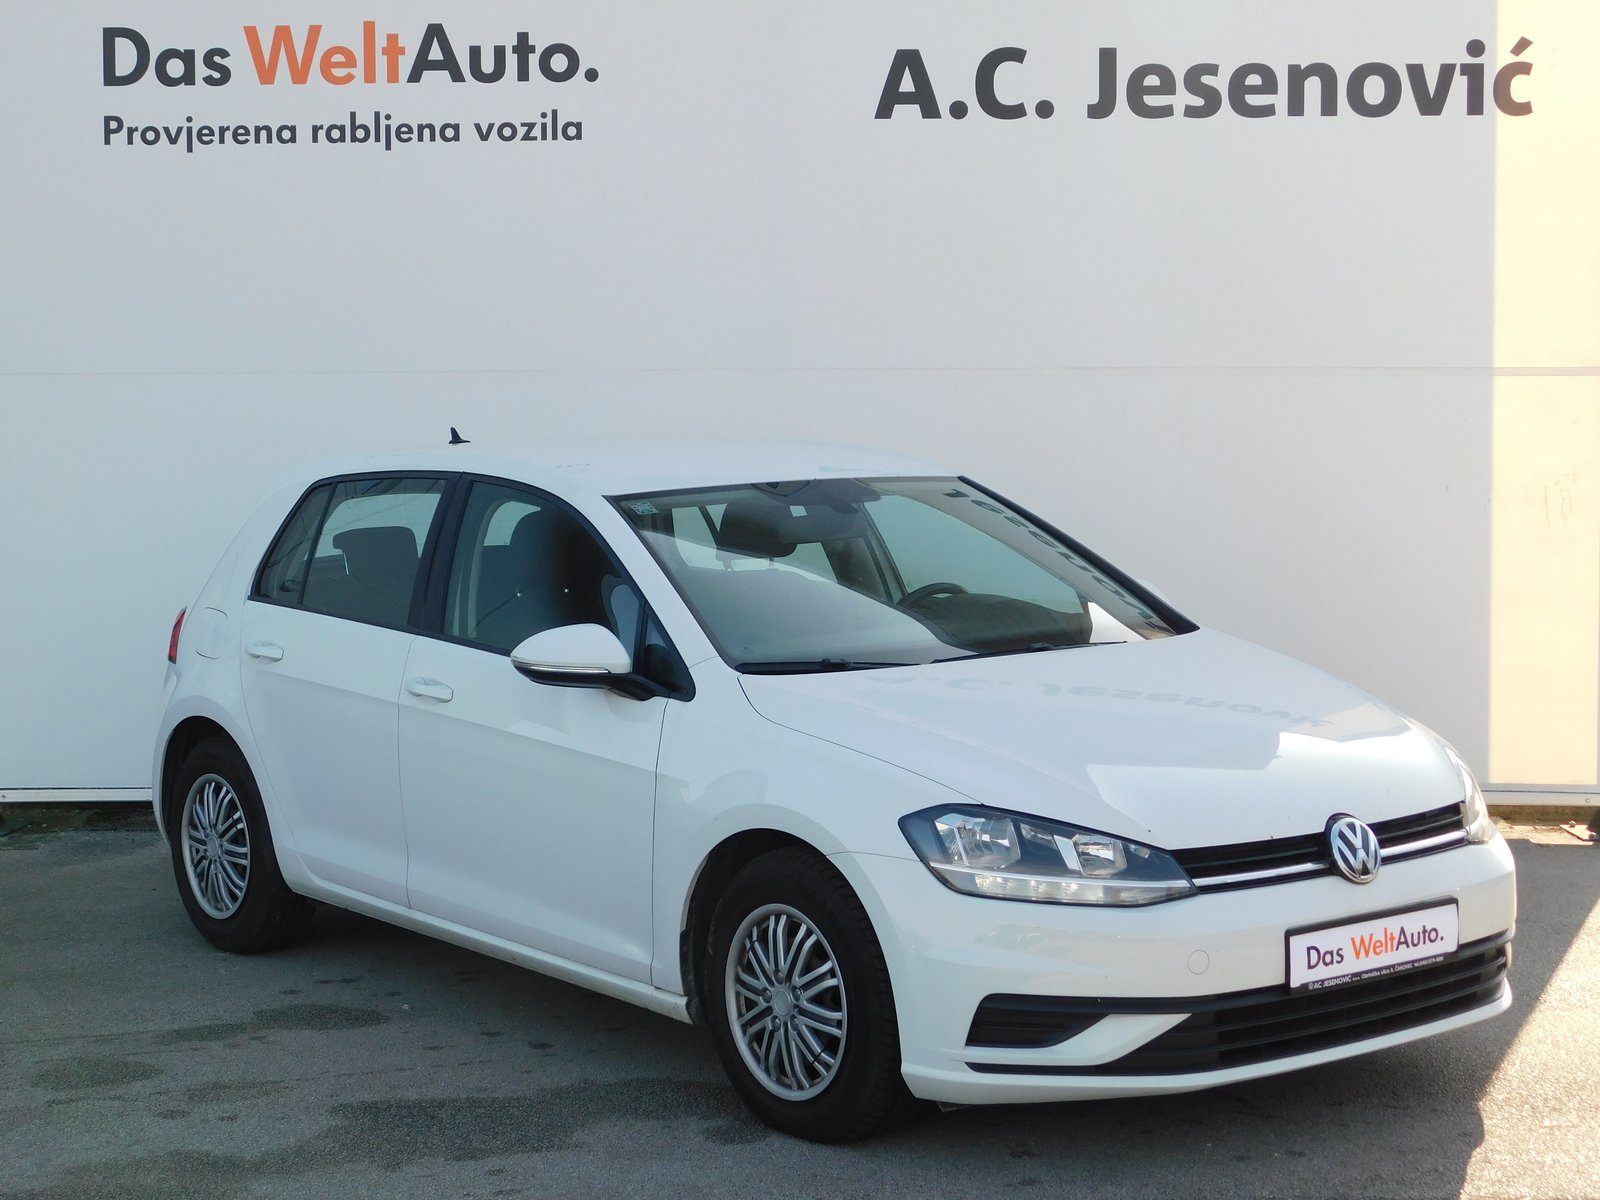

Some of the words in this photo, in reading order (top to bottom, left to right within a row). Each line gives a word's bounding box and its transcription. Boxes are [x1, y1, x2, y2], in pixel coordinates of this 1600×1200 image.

[102, 26, 232, 88] Das
[243, 20, 600, 86] WeltAuto.
[874, 46, 1055, 121] A.C.
[1086, 36, 1533, 120] Jesenović
[103, 115, 297, 153] Provjerena
[311, 110, 461, 152] rabljena
[472, 108, 584, 143] vozila
[1306, 945, 1345, 971] Das
[1350, 924, 1445, 961] WeltAuto.
